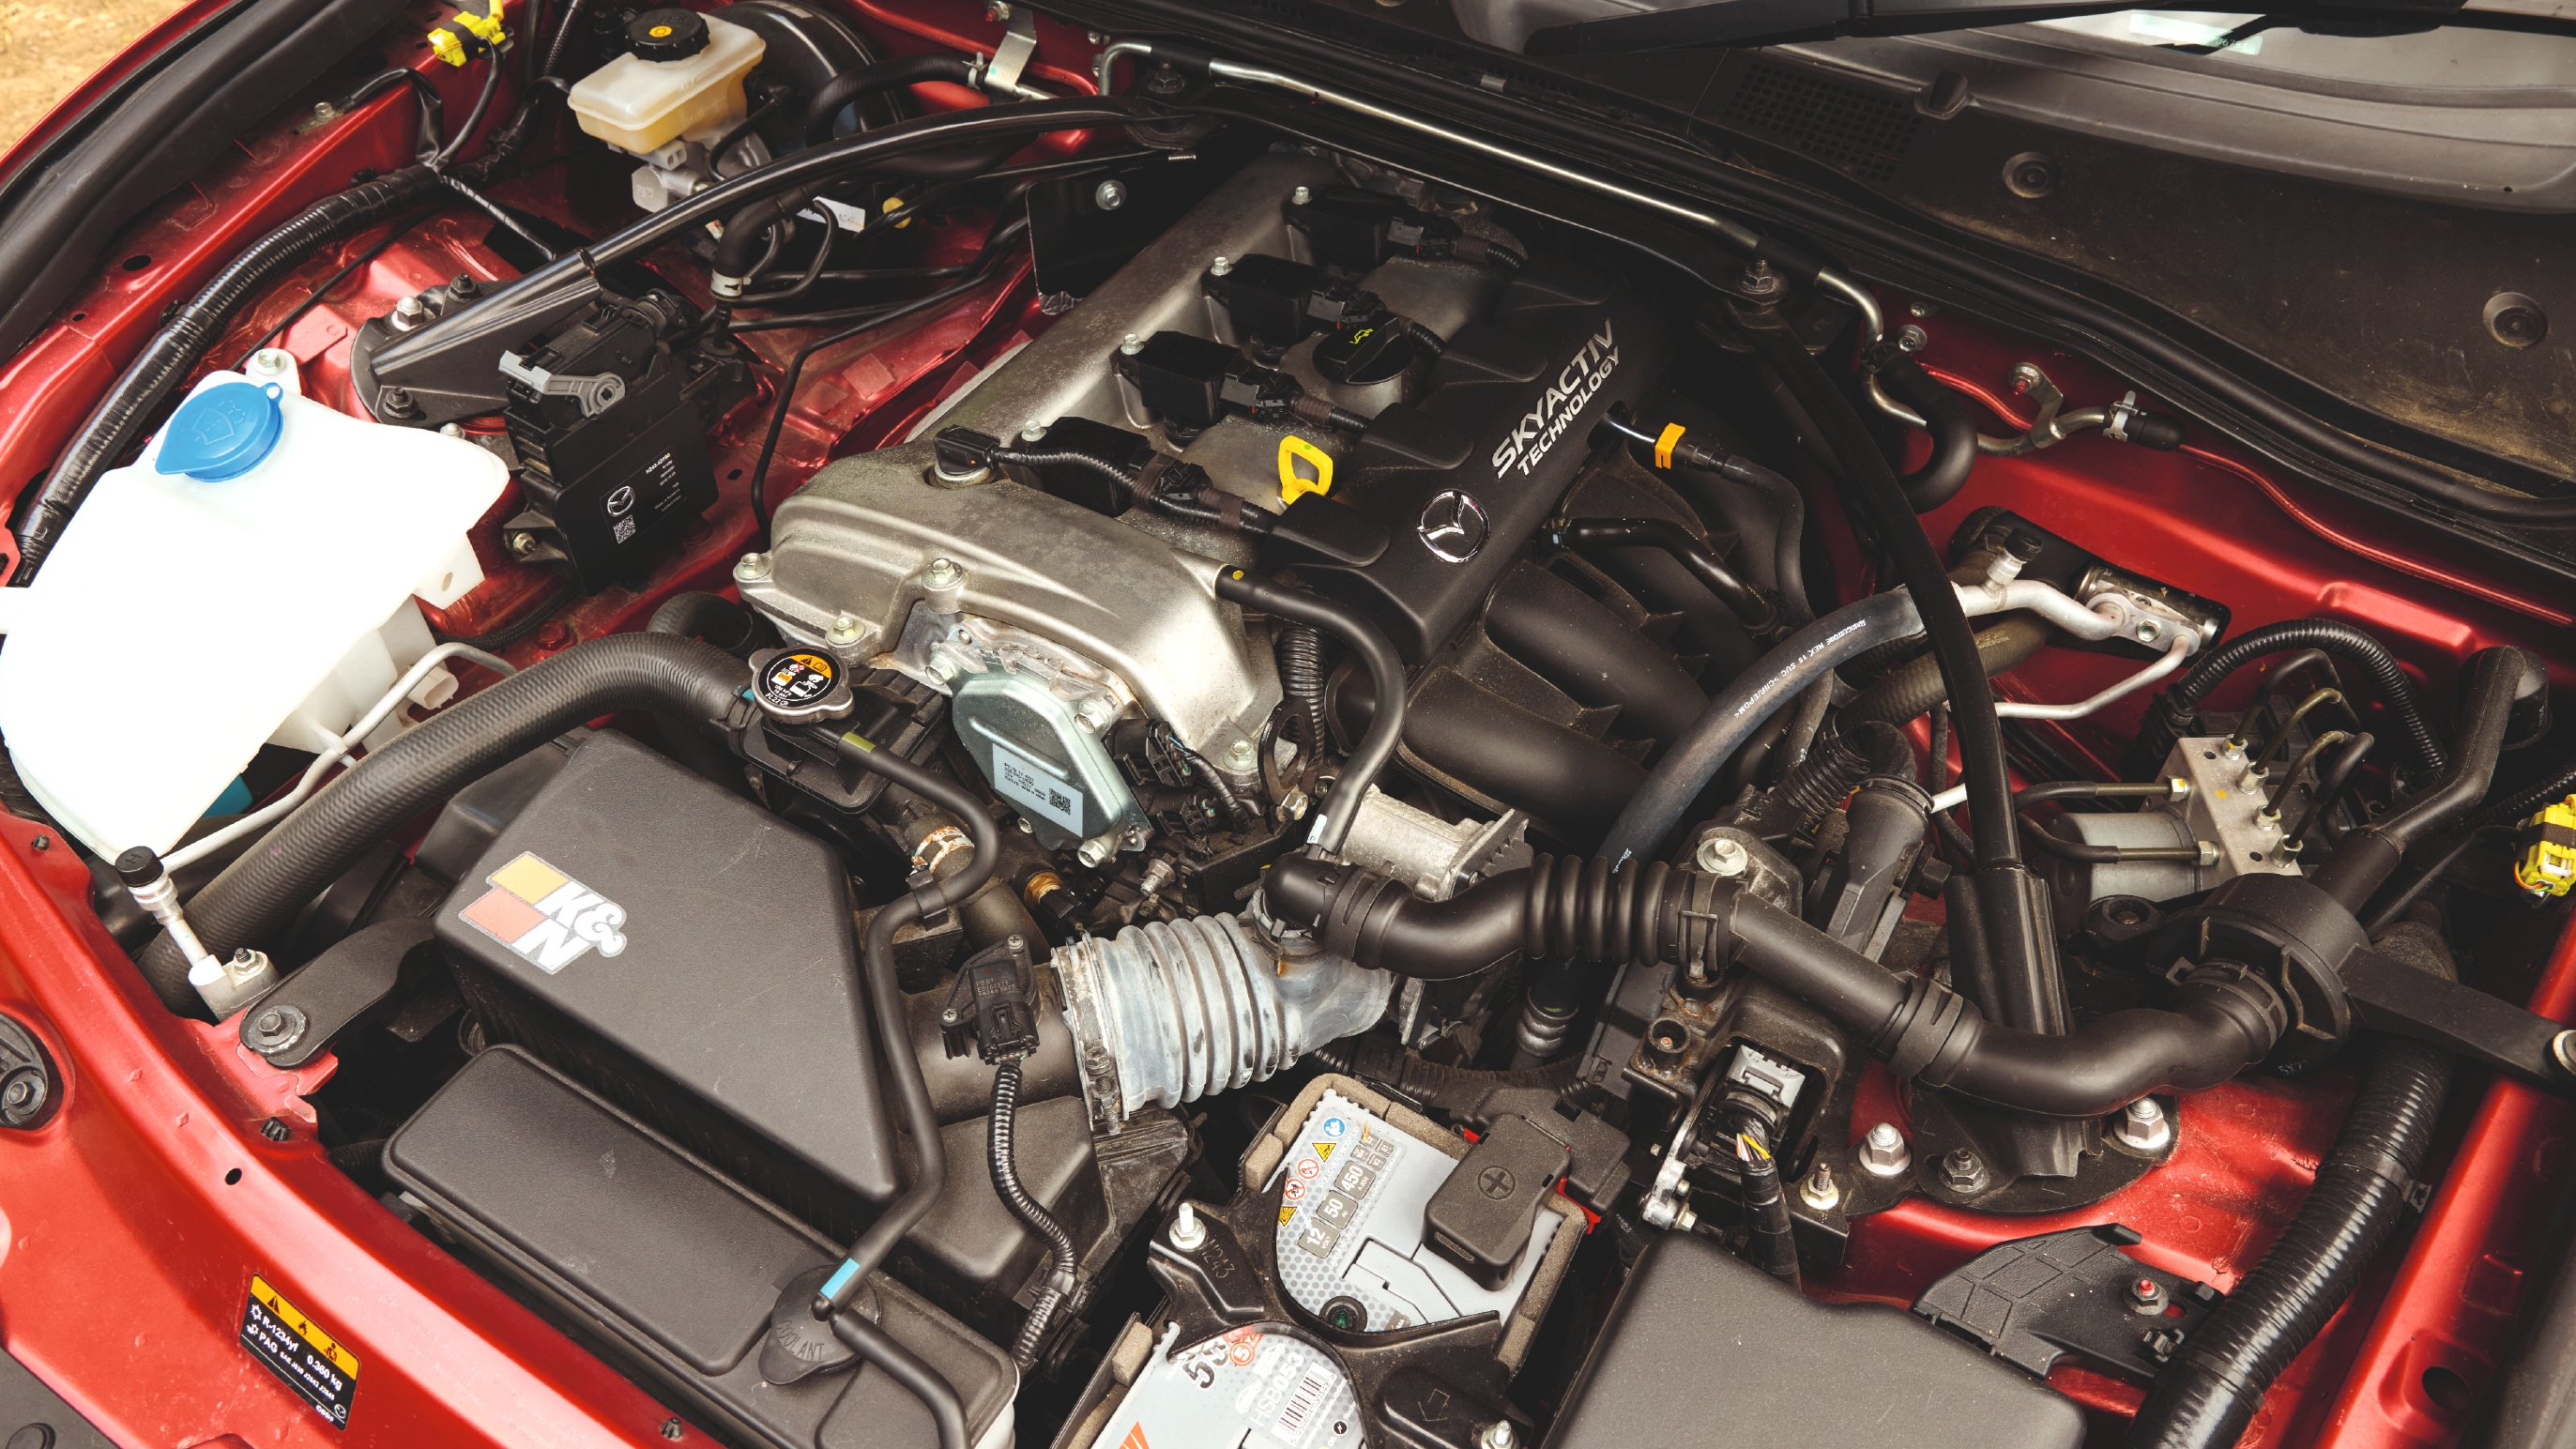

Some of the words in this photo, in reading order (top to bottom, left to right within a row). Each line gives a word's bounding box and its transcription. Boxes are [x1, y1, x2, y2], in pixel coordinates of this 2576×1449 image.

[1492, 318, 1613, 480] SKYACTIV
[1517, 345, 1620, 476] TECHNOLOGY
[511, 879, 624, 971] K&N
[1319, 1159, 1340, 1187] ROLLOVER
[1338, 1137, 1353, 1157] PROOF
[1306, 1227, 1326, 1245] 12
[1324, 1198, 1343, 1218] 50
[1341, 1165, 1364, 1191] 450
[1321, 1236, 1332, 1249] VOLT
[1329, 1228, 1354, 1265] MANUFACTURED
[1371, 1171, 1388, 1196] EUROPEAN
[1385, 1148, 1402, 1172] STANDARD
[259, 1332, 278, 1353] PAG
[263, 1316, 299, 1352] R-1234yf
[331, 1374, 343, 1391] kg
[776, 1319, 825, 1361] COOLANT
[1250, 1351, 1303, 1426] HSB053
[1328, 1437, 1336, 1446] OK
